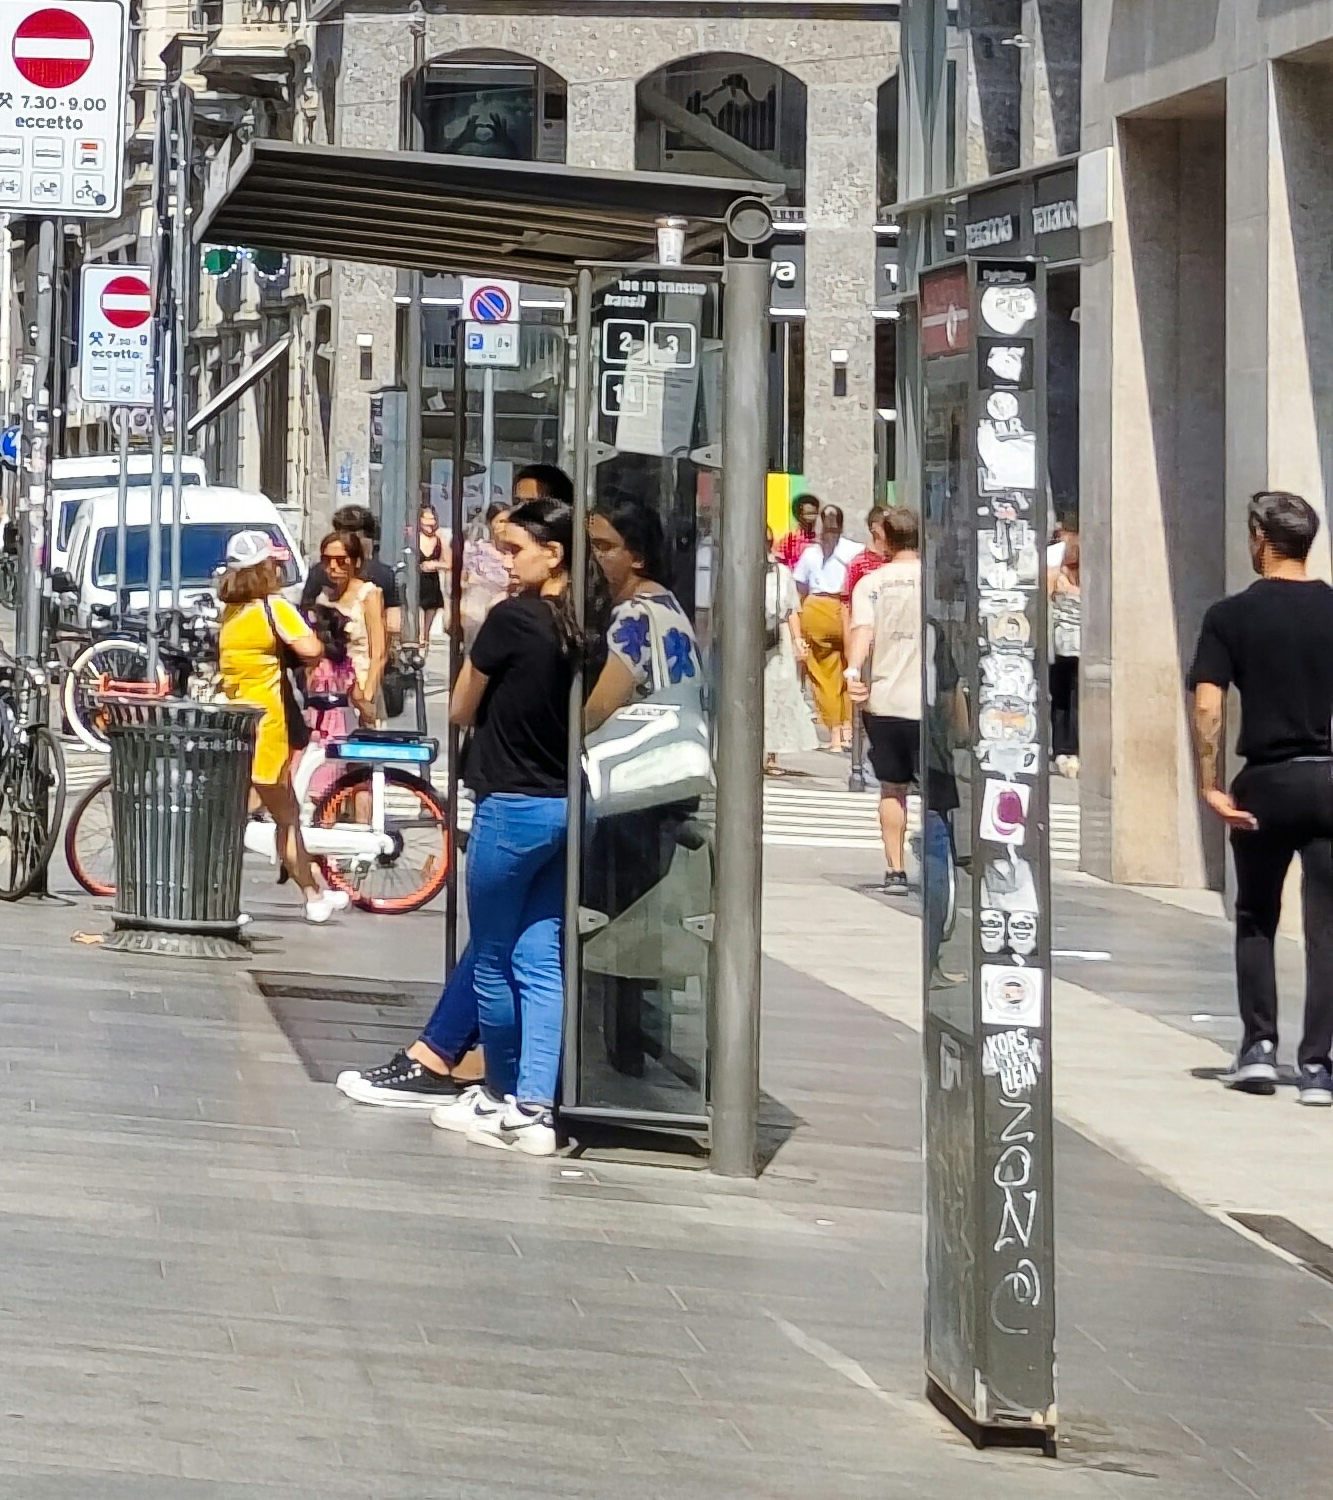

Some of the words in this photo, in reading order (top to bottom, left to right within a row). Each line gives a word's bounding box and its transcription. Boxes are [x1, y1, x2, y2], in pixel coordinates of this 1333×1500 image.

[20, 95, 57, 110] 7.30
[68, 97, 107, 111] 9.00
[15, 115, 83, 130] eccetto
[619, 331, 632, 352] 2
[666, 335, 679, 355] 3
